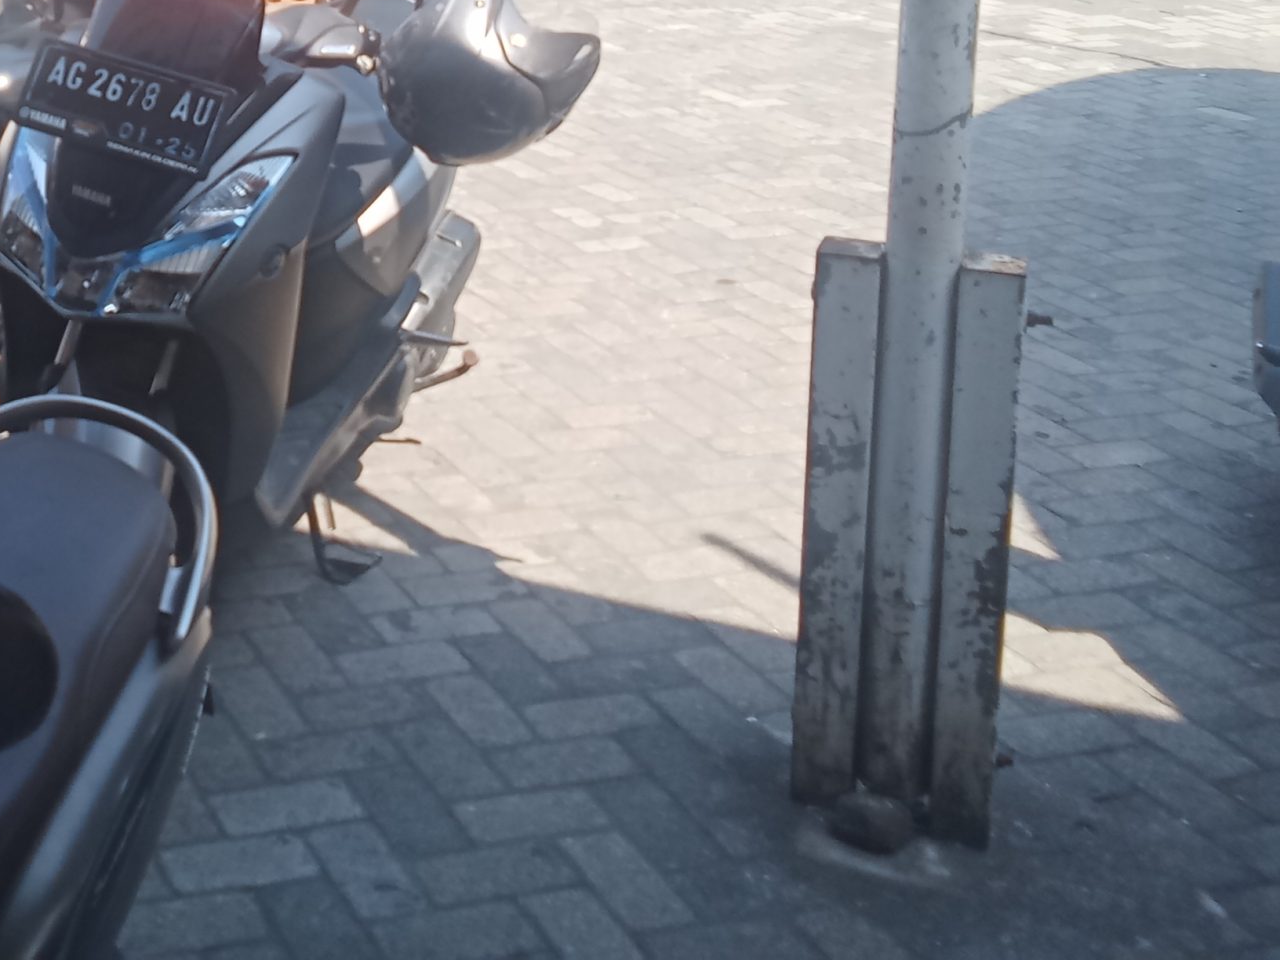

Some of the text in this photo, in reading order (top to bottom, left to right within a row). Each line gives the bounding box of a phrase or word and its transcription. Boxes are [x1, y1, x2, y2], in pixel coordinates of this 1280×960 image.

[47, 56, 216, 127] AG 2678 AU
